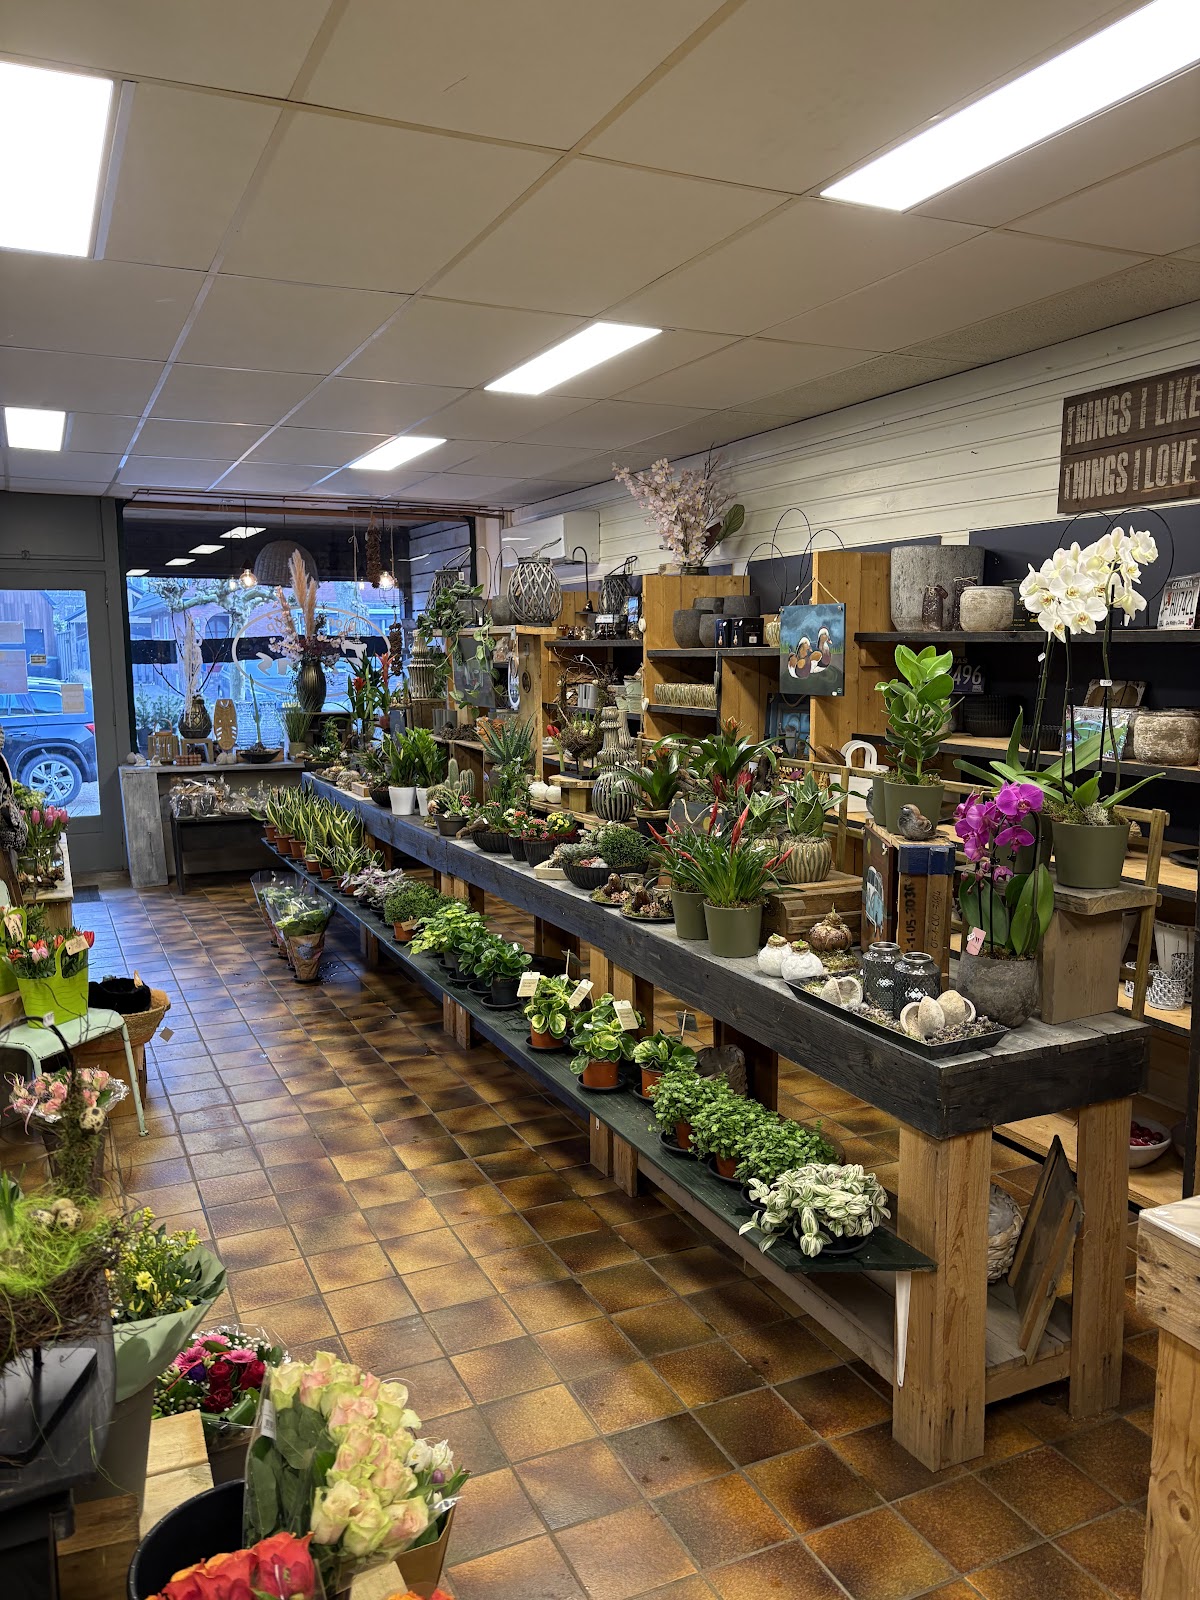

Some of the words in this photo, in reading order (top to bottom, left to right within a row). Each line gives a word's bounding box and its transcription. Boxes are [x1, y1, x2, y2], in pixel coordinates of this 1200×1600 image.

[1066, 392, 1132, 446] THINGS
[1139, 387, 1148, 430] I
[1155, 374, 1200, 426] LIKE
[1063, 451, 1129, 500] THINGS
[1132, 449, 1141, 491] I
[1144, 438, 1198, 489] LOVE
[947, 664, 982, 685] 496
